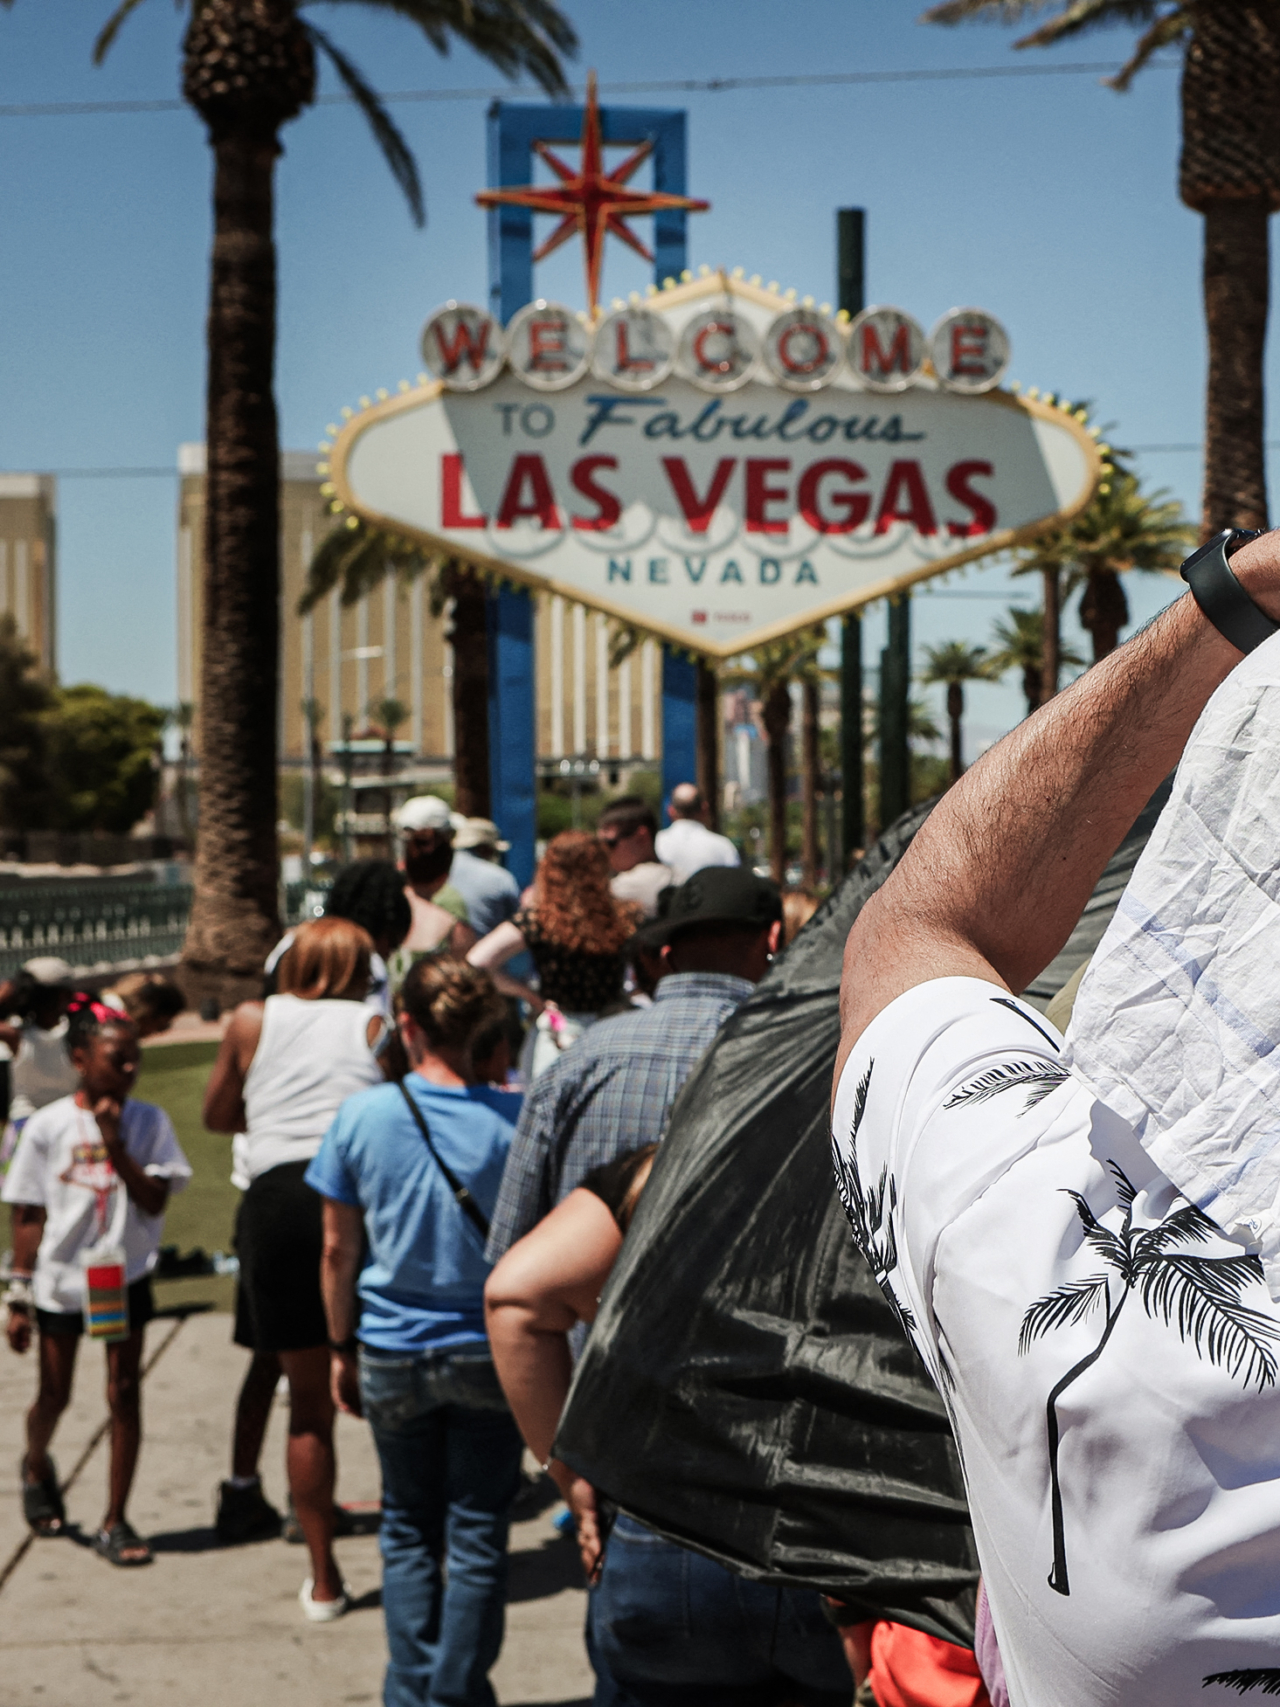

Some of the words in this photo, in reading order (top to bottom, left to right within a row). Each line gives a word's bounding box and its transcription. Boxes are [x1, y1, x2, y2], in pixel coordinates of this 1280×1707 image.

[430, 315, 989, 378] WELCOME
[496, 402, 556, 437] TO
[579, 395, 927, 446] Fabulous
[440, 452, 623, 533] LAS
[661, 455, 998, 539] VEGAS
[606, 555, 821, 587] NEVADA
